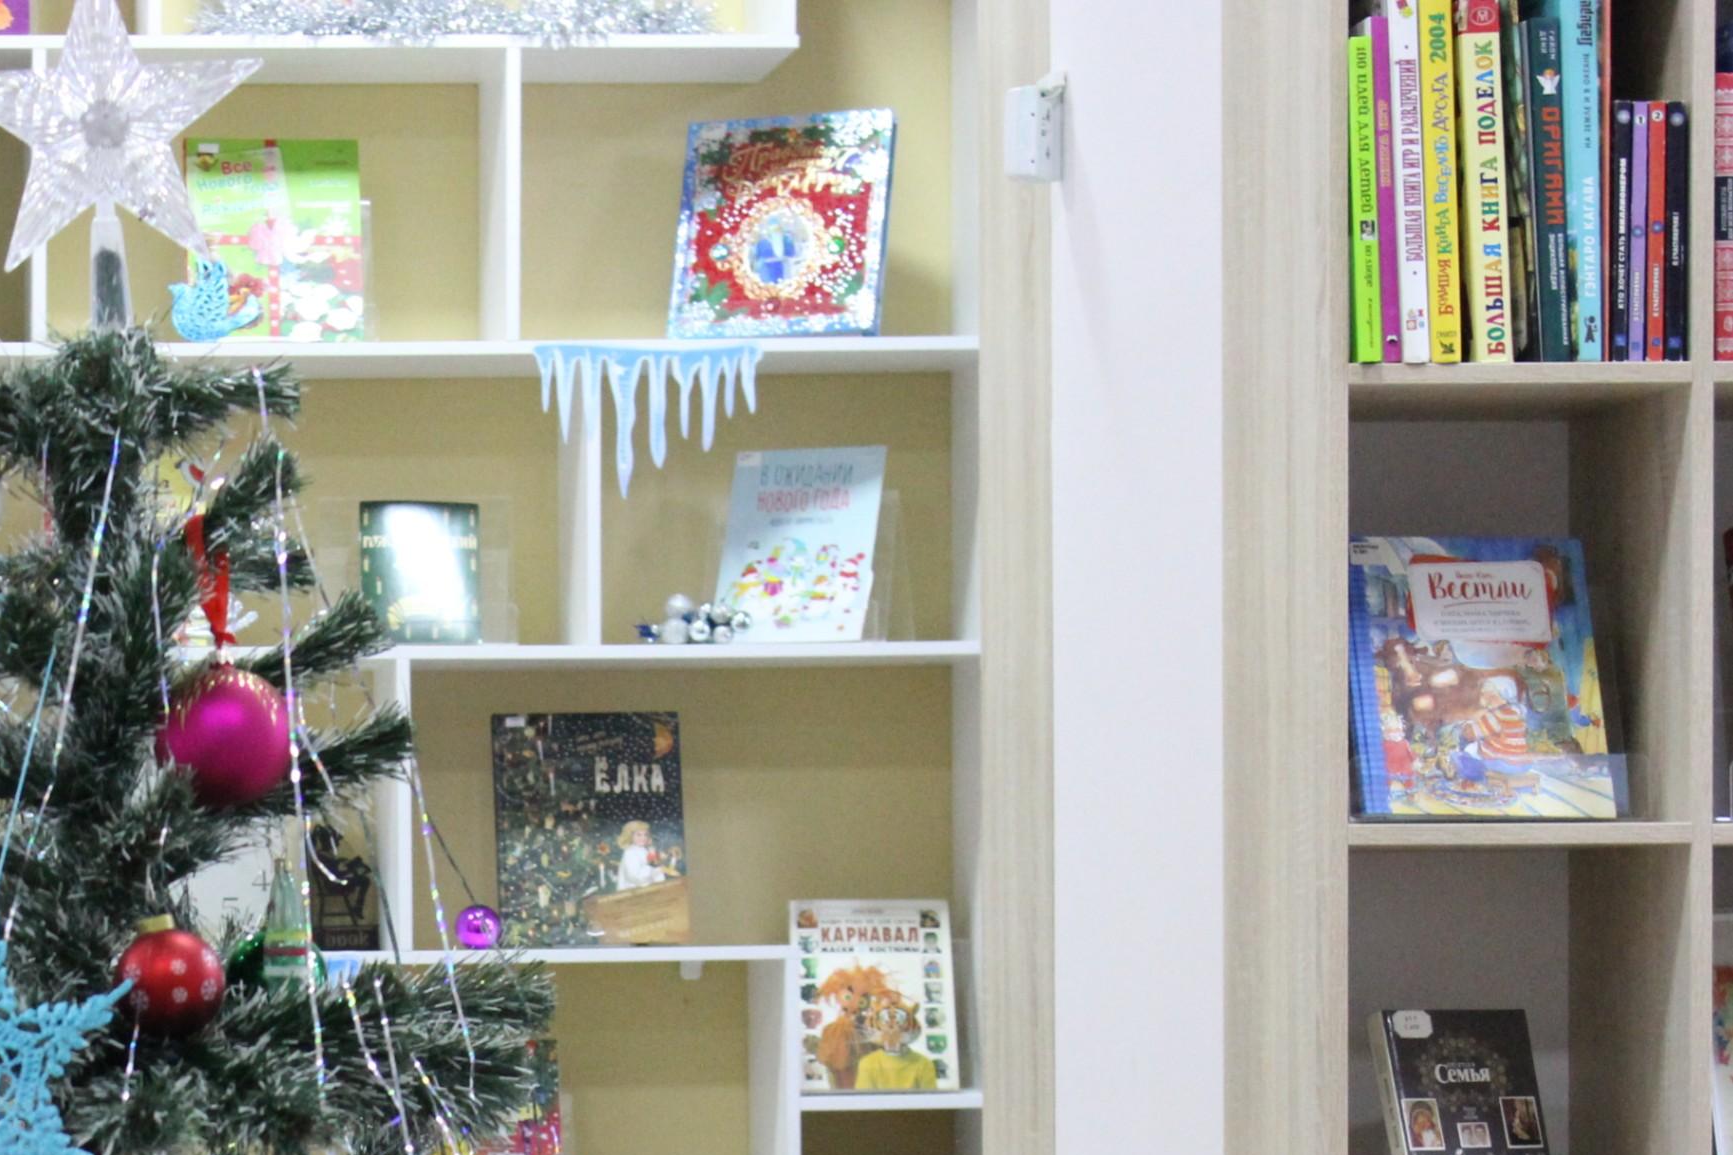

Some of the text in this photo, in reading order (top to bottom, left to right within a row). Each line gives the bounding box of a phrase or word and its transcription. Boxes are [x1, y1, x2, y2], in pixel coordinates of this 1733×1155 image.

[1428, 12, 1446, 63] 2004
[1357, 46, 1368, 70] 100
[221, 161, 253, 175] Все
[1394, 58, 1423, 262] БОЛЬШАЯ КНИГА ИГР И РАЗВЛЕЧЕНИЙ
[1541, 106, 1565, 226] ОРИГАМИ
[1474, 40, 1506, 356] БОЛЬШАЯ КНИГА ПОДЕЛОК
[1581, 176, 1597, 297] ГЭНТАРО КАГАВА
[1617, 157, 1627, 310] КТО ХОЧЕТ СТАТЬ МИЛЛИОНЕРОМ
[757, 485, 850, 512] НОВОГО ГОДА
[1428, 572, 1532, 600] Вестли
[594, 756, 665, 794] ЁЛКА
[251, 870, 269, 892] 4
[820, 927, 918, 943] КАРНАВАЛ
[821, 945, 854, 953] МАСКИ
[1434, 1063, 1491, 1084] Семья
